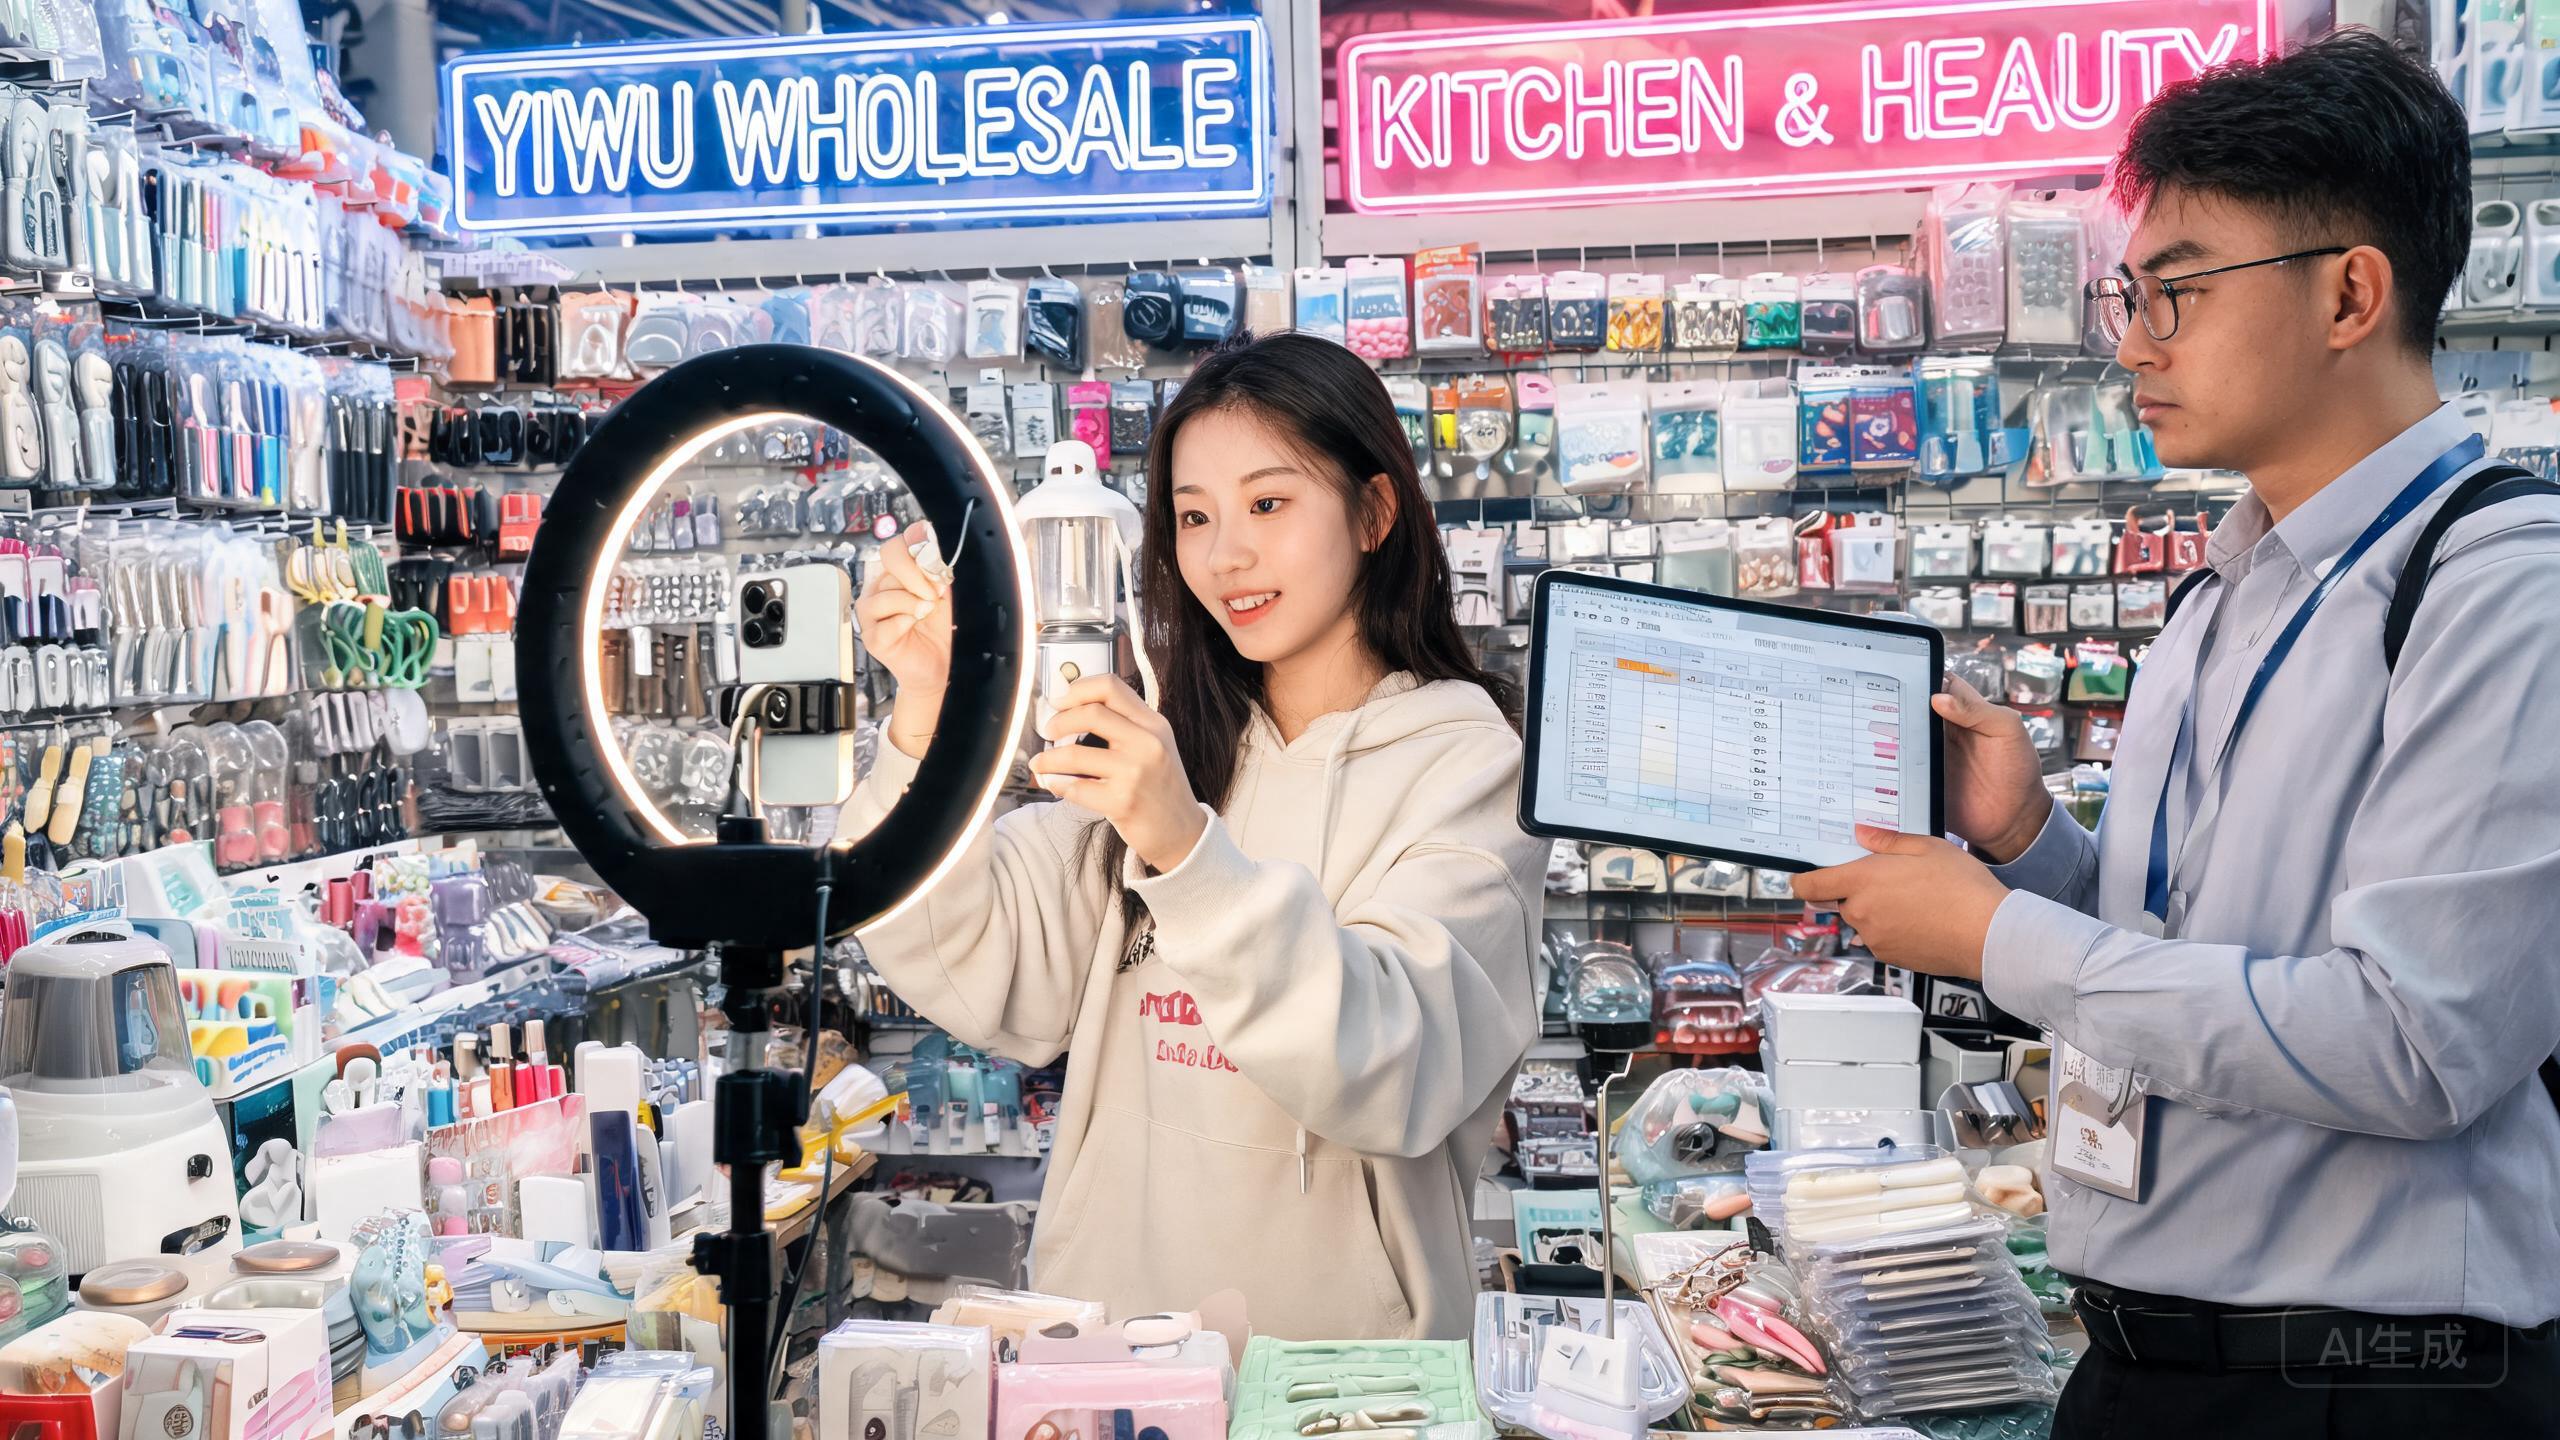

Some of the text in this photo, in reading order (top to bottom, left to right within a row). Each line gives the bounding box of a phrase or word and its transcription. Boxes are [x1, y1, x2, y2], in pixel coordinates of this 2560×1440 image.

[474, 58, 1238, 197] YIWU WHOLESALE
[1371, 54, 1745, 169] KITCHEN
[1775, 73, 1835, 147] &
